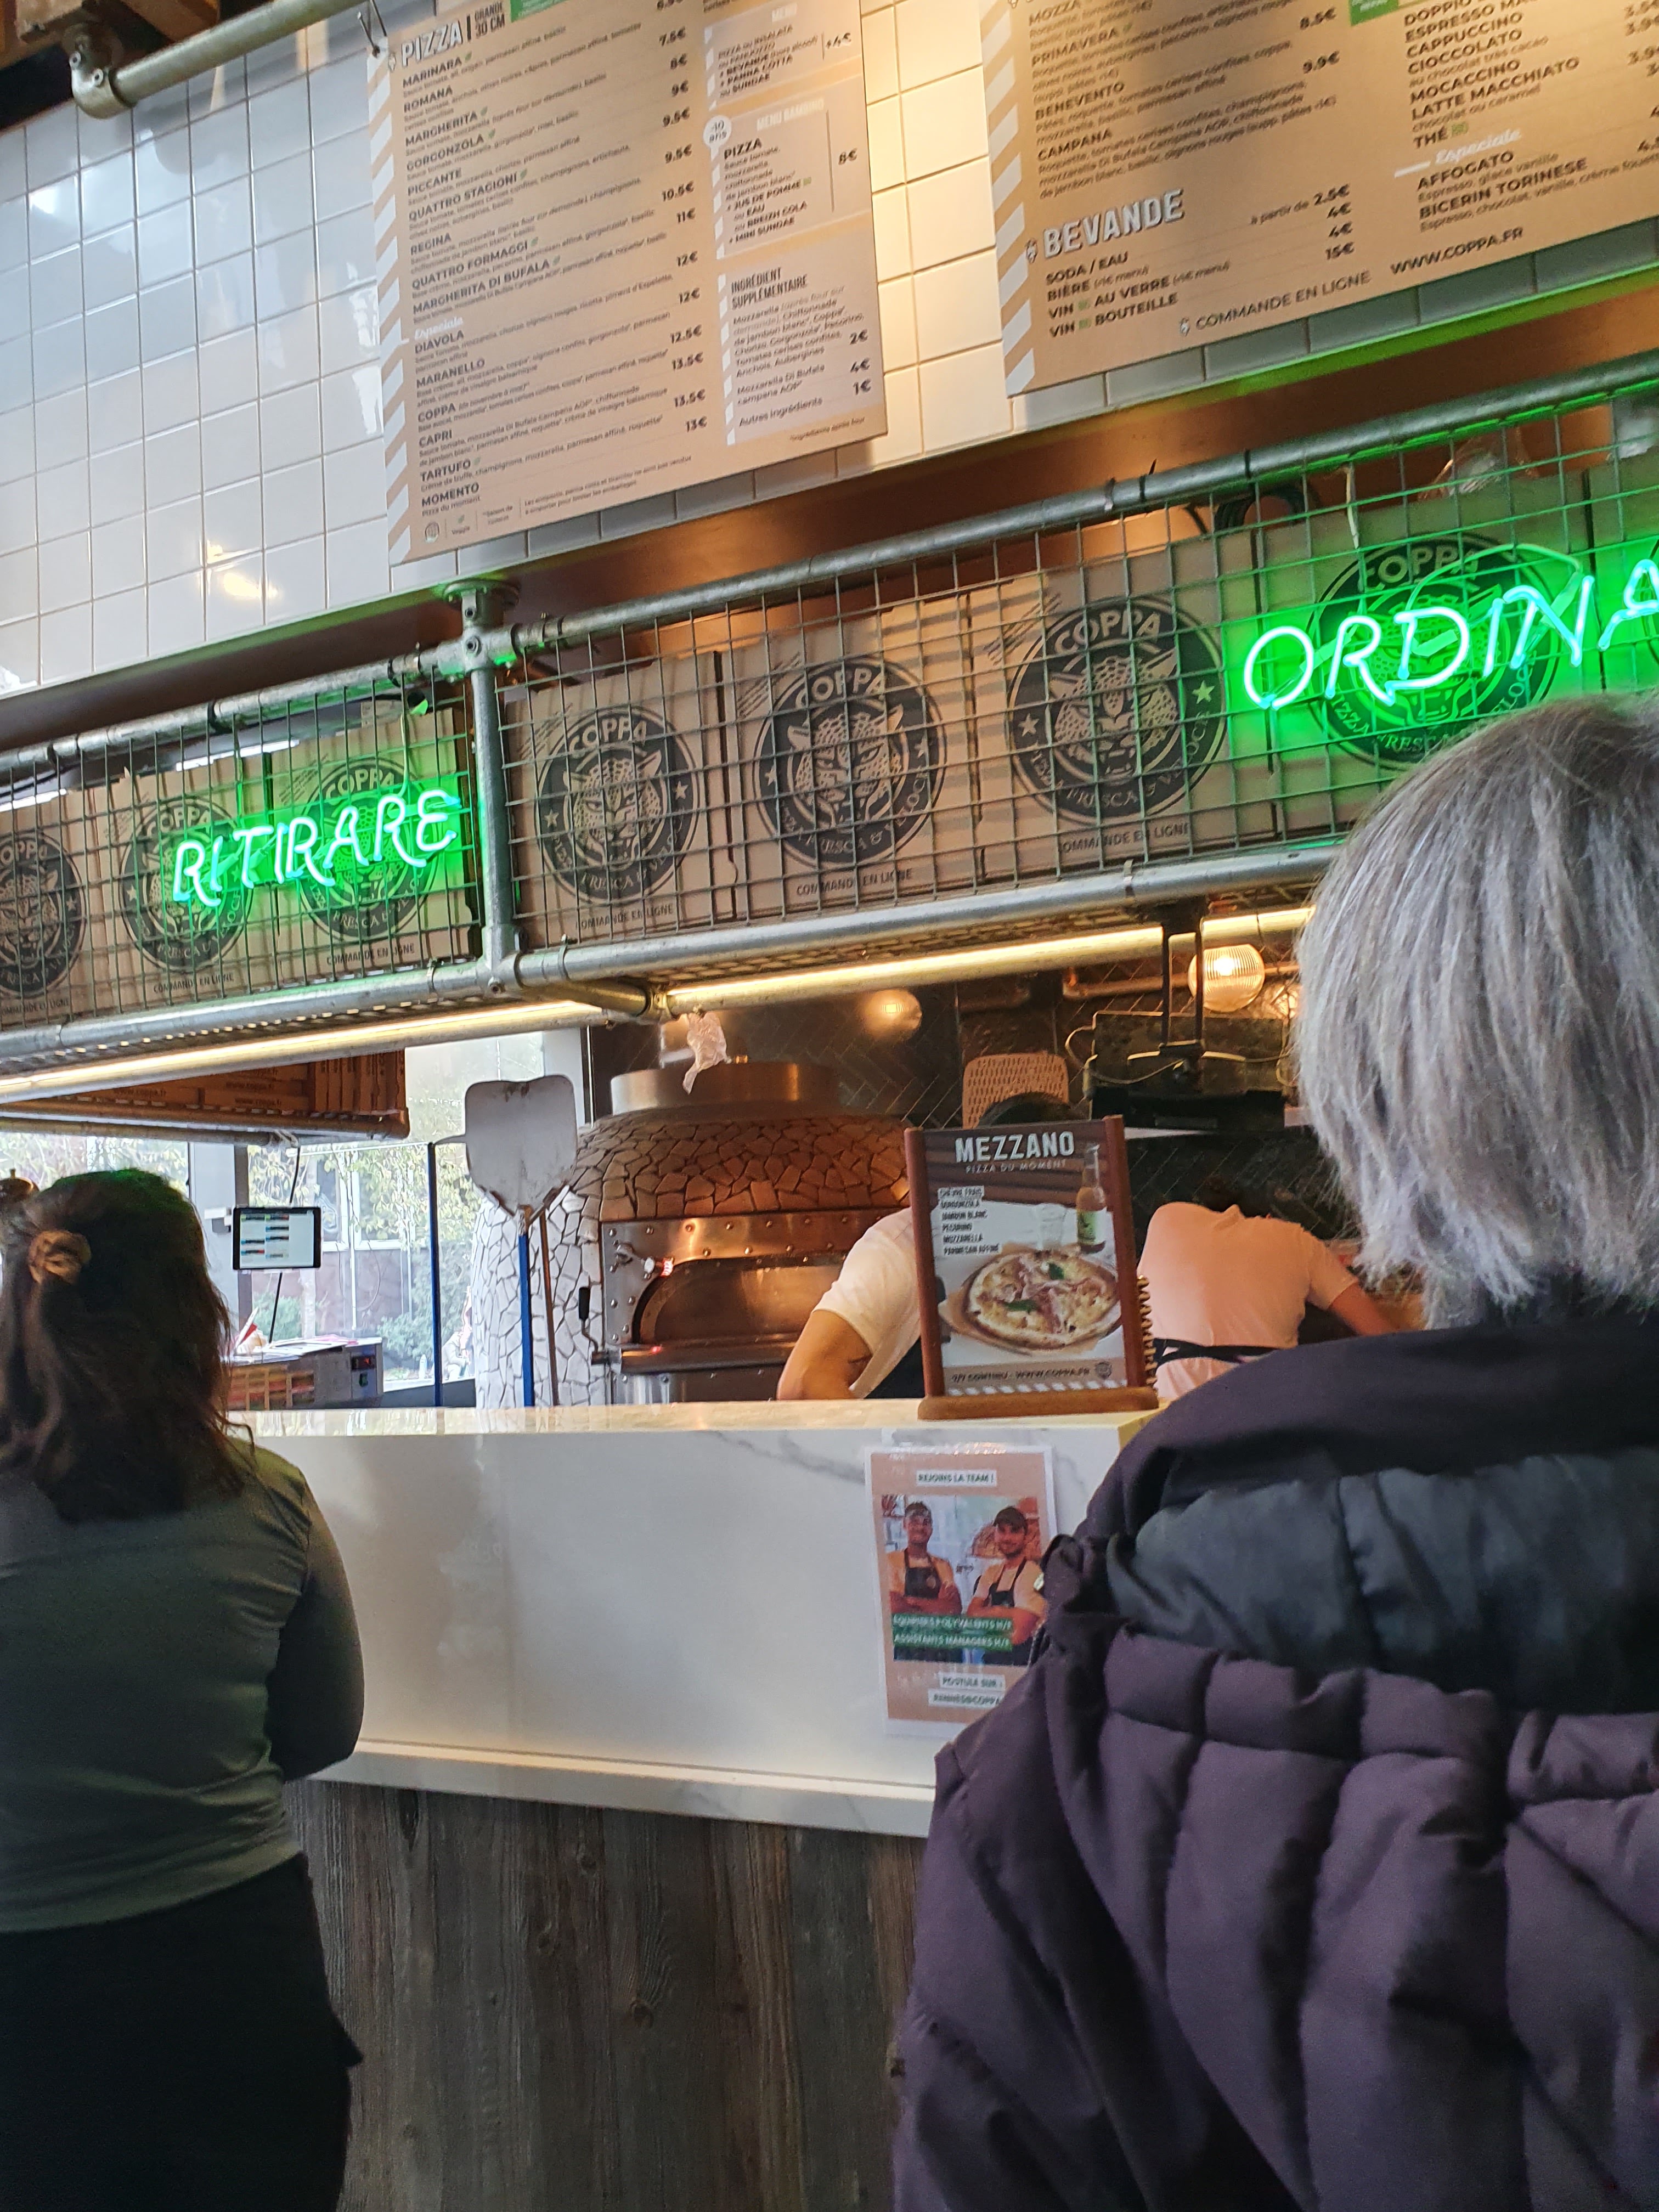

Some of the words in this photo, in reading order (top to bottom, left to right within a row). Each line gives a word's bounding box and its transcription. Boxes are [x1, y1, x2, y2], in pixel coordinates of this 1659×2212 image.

[476, 20, 487, 38] 30
[490, 13, 505, 32] CM
[1299, 7, 1336, 30] 8.5€
[1404, 0, 1471, 26] DOPPIO
[1405, 3, 1494, 42] ESPRESSO
[401, 19, 462, 67] PIZZA
[1032, 26, 1117, 66] PRIMAVERA
[1407, 9, 1523, 59] CAPPUCCINO
[1302, 50, 1340, 74] 9.9€
[1408, 27, 1522, 75] CIOCCOLATO
[403, 55, 461, 88] MARINARA
[1410, 58, 1520, 104] MOCACCINO
[404, 84, 452, 112] ROMANA
[1035, 79, 1125, 121] BENEVENTO
[1412, 92, 1465, 120] LATTE
[1470, 56, 1579, 101] MACCHIATO
[1413, 108, 1465, 131] chocolat
[1469, 101, 1485, 114] ou
[1488, 83, 1541, 108] caramel
[405, 110, 477, 146] MARGHERITA
[1414, 126, 1448, 149] THÉ
[407, 133, 483, 171] GORGONZOLA
[665, 144, 692, 163] 9.5€
[724, 137, 761, 160] PIZZA
[839, 148, 857, 165] 8€
[1037, 127, 1111, 162] CAMPANA
[408, 167, 461, 196] PICCANTE
[1417, 150, 1514, 189] AFFOGATO
[409, 193, 461, 222] QUATTRO
[464, 172, 517, 201] STAGIONI
[662, 180, 694, 202] 10.5€
[1313, 184, 1350, 205] 2.5€
[1420, 187, 1491, 218] BICERIN
[1496, 159, 1587, 195] TORINESE
[676, 207, 695, 223] 11€
[747, 204, 765, 217] EAU
[1043, 188, 1185, 259] BEVANDE
[1326, 202, 1351, 219] 4€
[410, 232, 451, 255] REGINA
[1328, 221, 1353, 239] 4€
[677, 251, 697, 267] 12€
[1326, 241, 1355, 259] 15€
[1391, 227, 1523, 274] WWW.COPPA.FR
[412, 263, 464, 290] QUATTRO
[468, 241, 527, 270] FORMAGGI
[1046, 262, 1086, 285] SODA
[1098, 249, 1128, 269] EAU
[413, 280, 485, 314] MARGHERITA
[489, 275, 500, 288] DI
[504, 258, 549, 283] BUFALA
[731, 266, 781, 294] INGRÉDIENT
[732, 274, 807, 309] SUPPLÉMENTAIRE
[1047, 278, 1090, 301] BIÈRE
[679, 287, 699, 303] 12€
[1048, 303, 1074, 320] VIN
[1094, 291, 1115, 307] AU
[1120, 275, 1170, 299] VERRE
[1196, 292, 1292, 330] COMMANDE
[1295, 285, 1317, 302] EN
[1322, 270, 1370, 295] LIGNE
[1049, 321, 1075, 338] VIN
[1095, 291, 1178, 325] BOUTEILLE
[415, 329, 463, 354] DIAVOLA
[670, 324, 702, 343] 12.5€
[849, 330, 867, 345] 2€
[672, 351, 703, 370] 13.5€
[775, 345, 824, 367] Aubergines
[850, 358, 870, 373] 4€
[417, 358, 484, 387] MARANELLO
[853, 379, 871, 394] 1€
[418, 403, 455, 422] COPPA
[674, 389, 705, 408] 13.5€
[740, 411, 768, 427] Autres
[770, 396, 822, 419] ingrédients
[419, 429, 451, 447] CAPRI
[686, 416, 707, 432] 13€
[421, 459, 470, 482] TARTUFO
[422, 482, 478, 507] MOMENTO
[1054, 608, 1161, 656] COPPA
[794, 667, 885, 710] COPPA
[568, 716, 647, 759] COPPA
[325, 768, 395, 805] COPPA
[145, 806, 212, 837] COPPA
[0, 839, 48, 863] OPPA
[172, 788, 462, 908] RITIRARE
[955, 1130, 1075, 1163] MEZZANO
[966, 1163, 996, 1174] PIZZA
[1000, 1162, 1015, 1172] DU
[1019, 1158, 1067, 1171] MOMENT
[967, 1473, 989, 1483] TEAM
